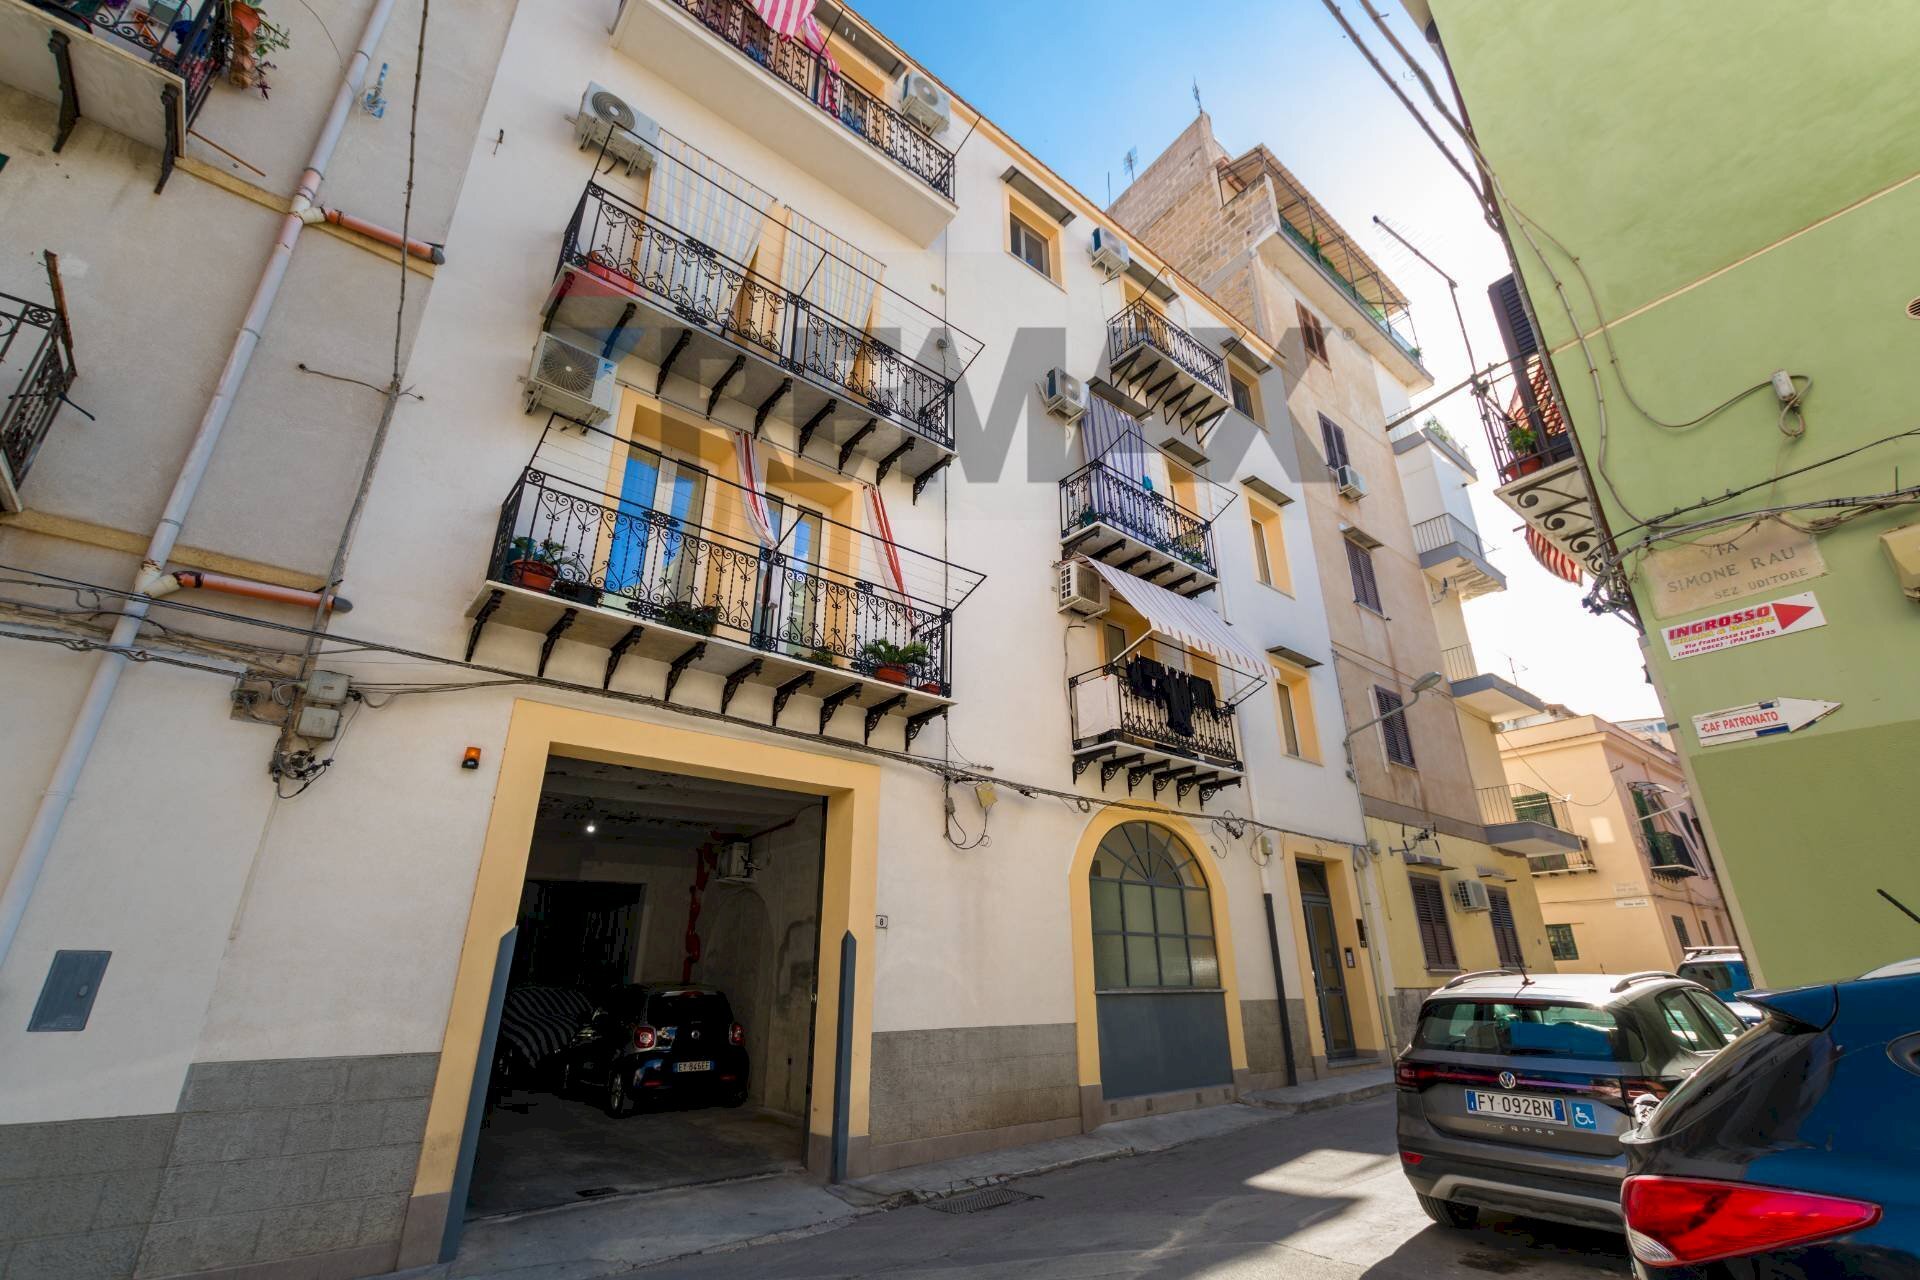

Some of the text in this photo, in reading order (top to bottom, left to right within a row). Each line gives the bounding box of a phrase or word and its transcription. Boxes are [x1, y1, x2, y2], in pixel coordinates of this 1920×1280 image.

[1667, 547, 1796, 593] SIMONE RAU
[1748, 568, 1809, 590] UDITORE
[1668, 606, 1771, 640] INGROSSO
[1703, 711, 1778, 733] CAF PATRONATO
[879, 918, 884, 926] 8
